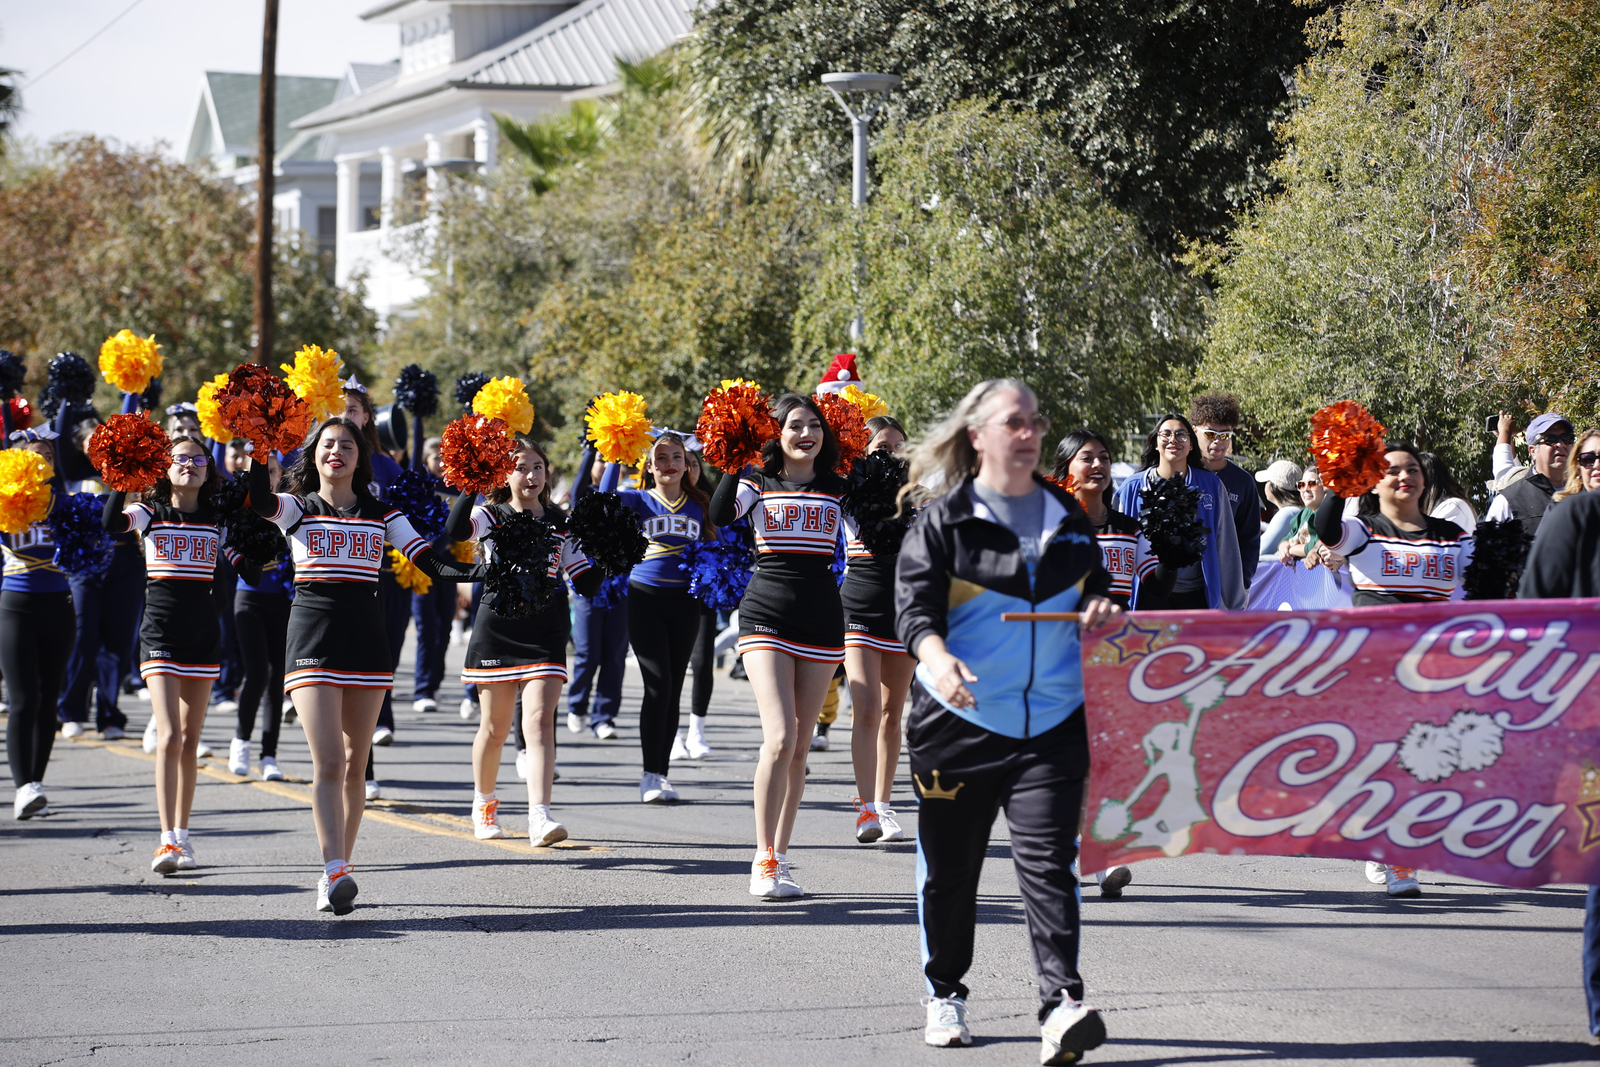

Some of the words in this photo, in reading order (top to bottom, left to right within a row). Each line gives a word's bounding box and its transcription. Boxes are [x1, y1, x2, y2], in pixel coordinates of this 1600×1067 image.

[643, 514, 700, 541] IDEA
[762, 504, 838, 535] EPHS
[9, 526, 54, 551] IDE
[154, 533, 218, 562] EPHS
[307, 529, 382, 561] EPHS
[1382, 549, 1455, 581] EPHS
[754, 624, 779, 635] TIGERS
[848, 623, 870, 633] TIGERS
[149, 650, 172, 659] TIGERS
[295, 658, 319, 667] TIGERS
[480, 659, 502, 668] TIGERS
[1128, 617, 1372, 703] All
[1395, 612, 1600, 732] City
[1211, 721, 1567, 869] Cheer
